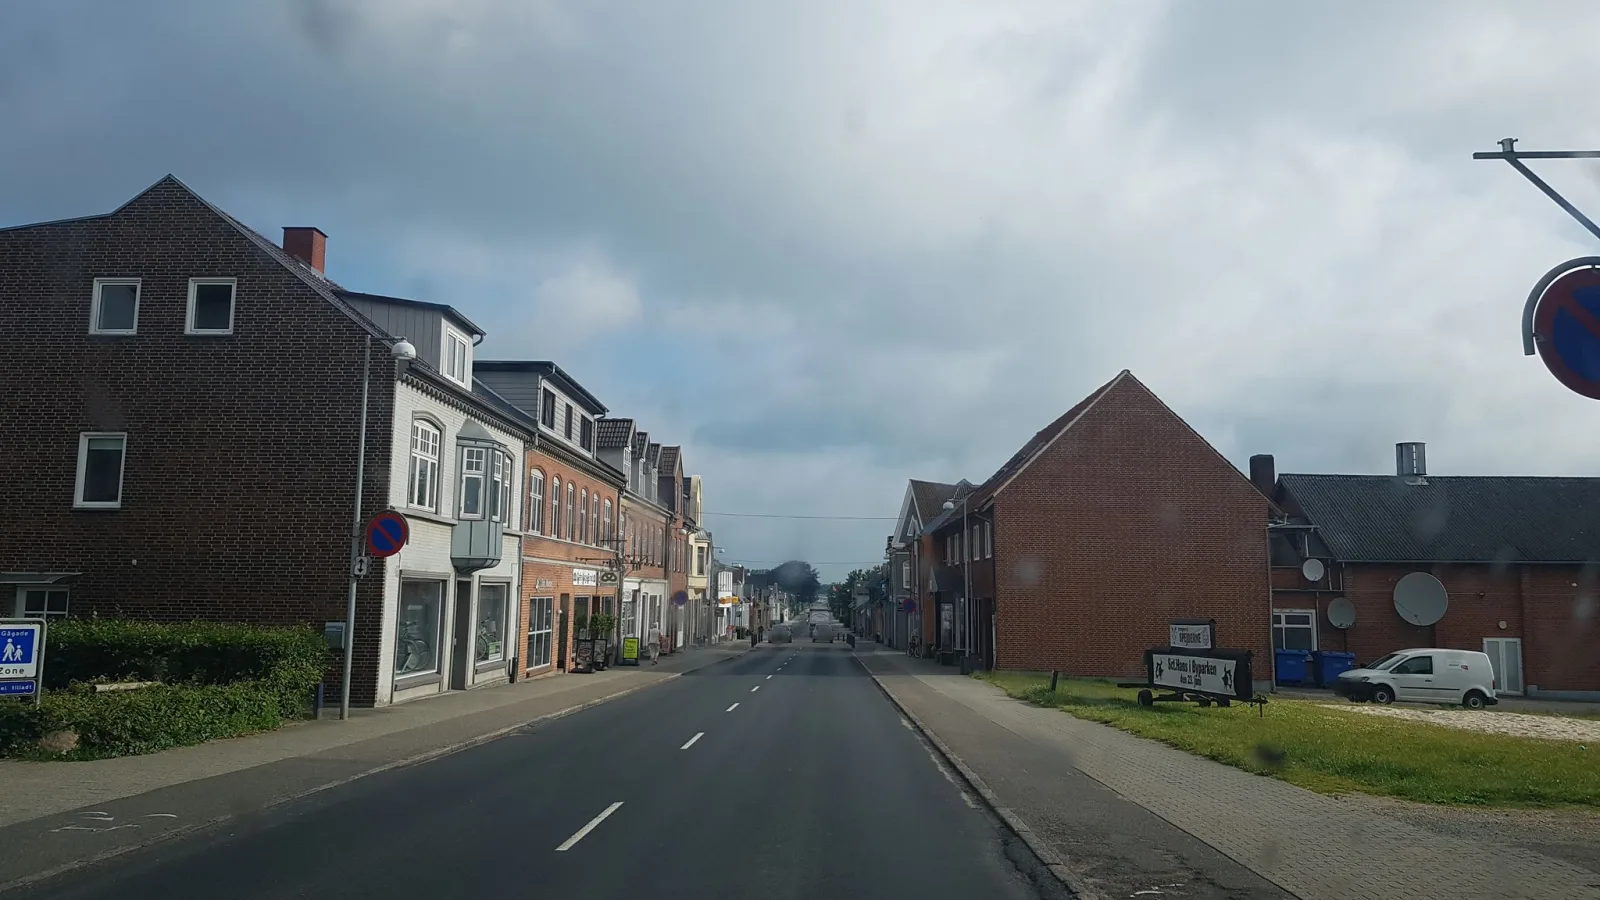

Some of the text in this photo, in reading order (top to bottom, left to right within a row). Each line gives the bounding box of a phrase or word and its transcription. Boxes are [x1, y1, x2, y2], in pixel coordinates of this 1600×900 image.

[1, 630, 29, 638] Gågade
[0, 667, 25, 675] Zone
[1192, 661, 1217, 677] Byparken
